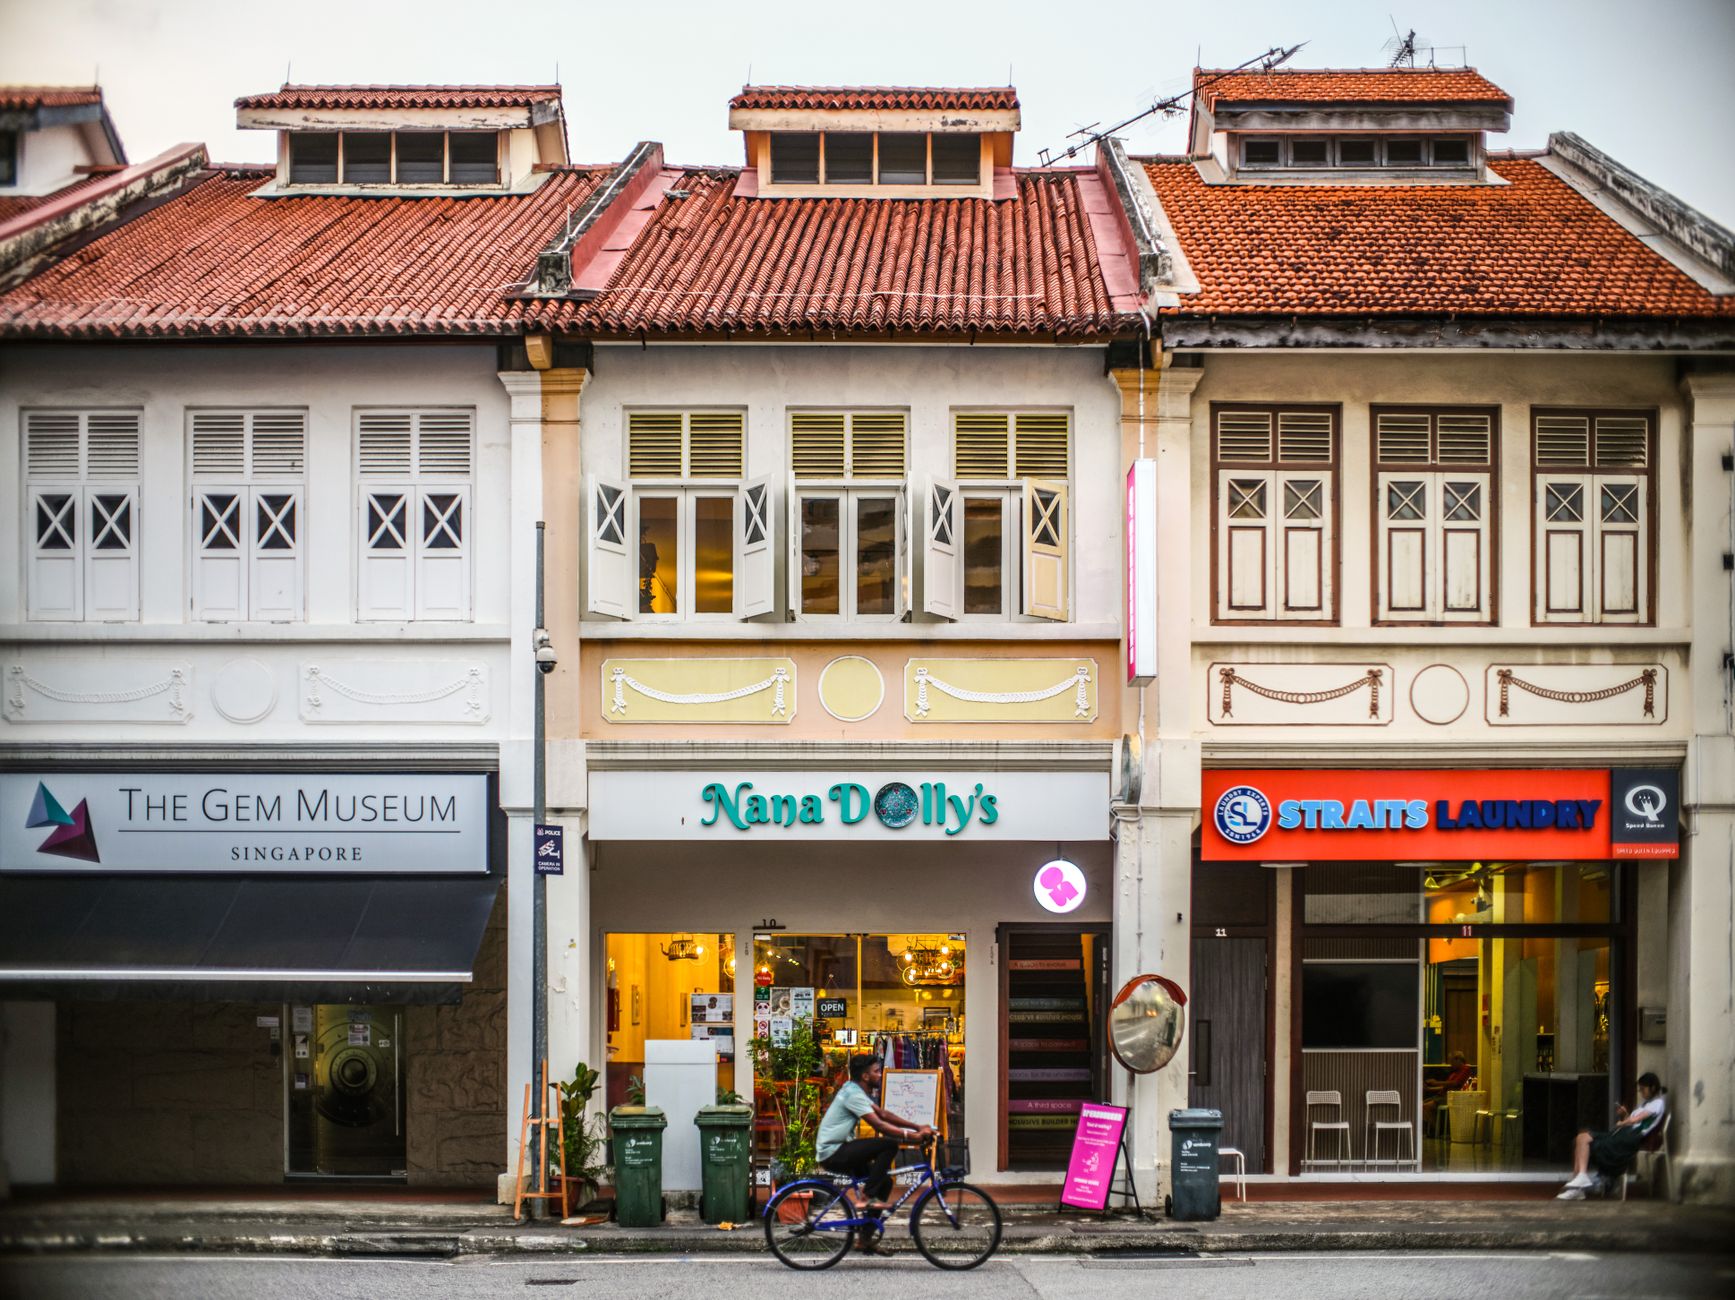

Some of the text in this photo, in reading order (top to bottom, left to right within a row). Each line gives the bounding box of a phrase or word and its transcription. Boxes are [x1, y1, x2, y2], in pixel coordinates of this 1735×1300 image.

[118, 788, 456, 822] THE GEM MUSEUM
[701, 781, 824, 830] Nana
[1278, 799, 1602, 829] STRAITS LAUNDRY
[231, 847, 362, 861] SINGAPORE
[762, 919, 776, 928] 10
[1215, 928, 1227, 937] 11
[1463, 925, 1472, 937] 11
[821, 1003, 845, 1012] OPEN
[1052, 1102, 1072, 1110] space
